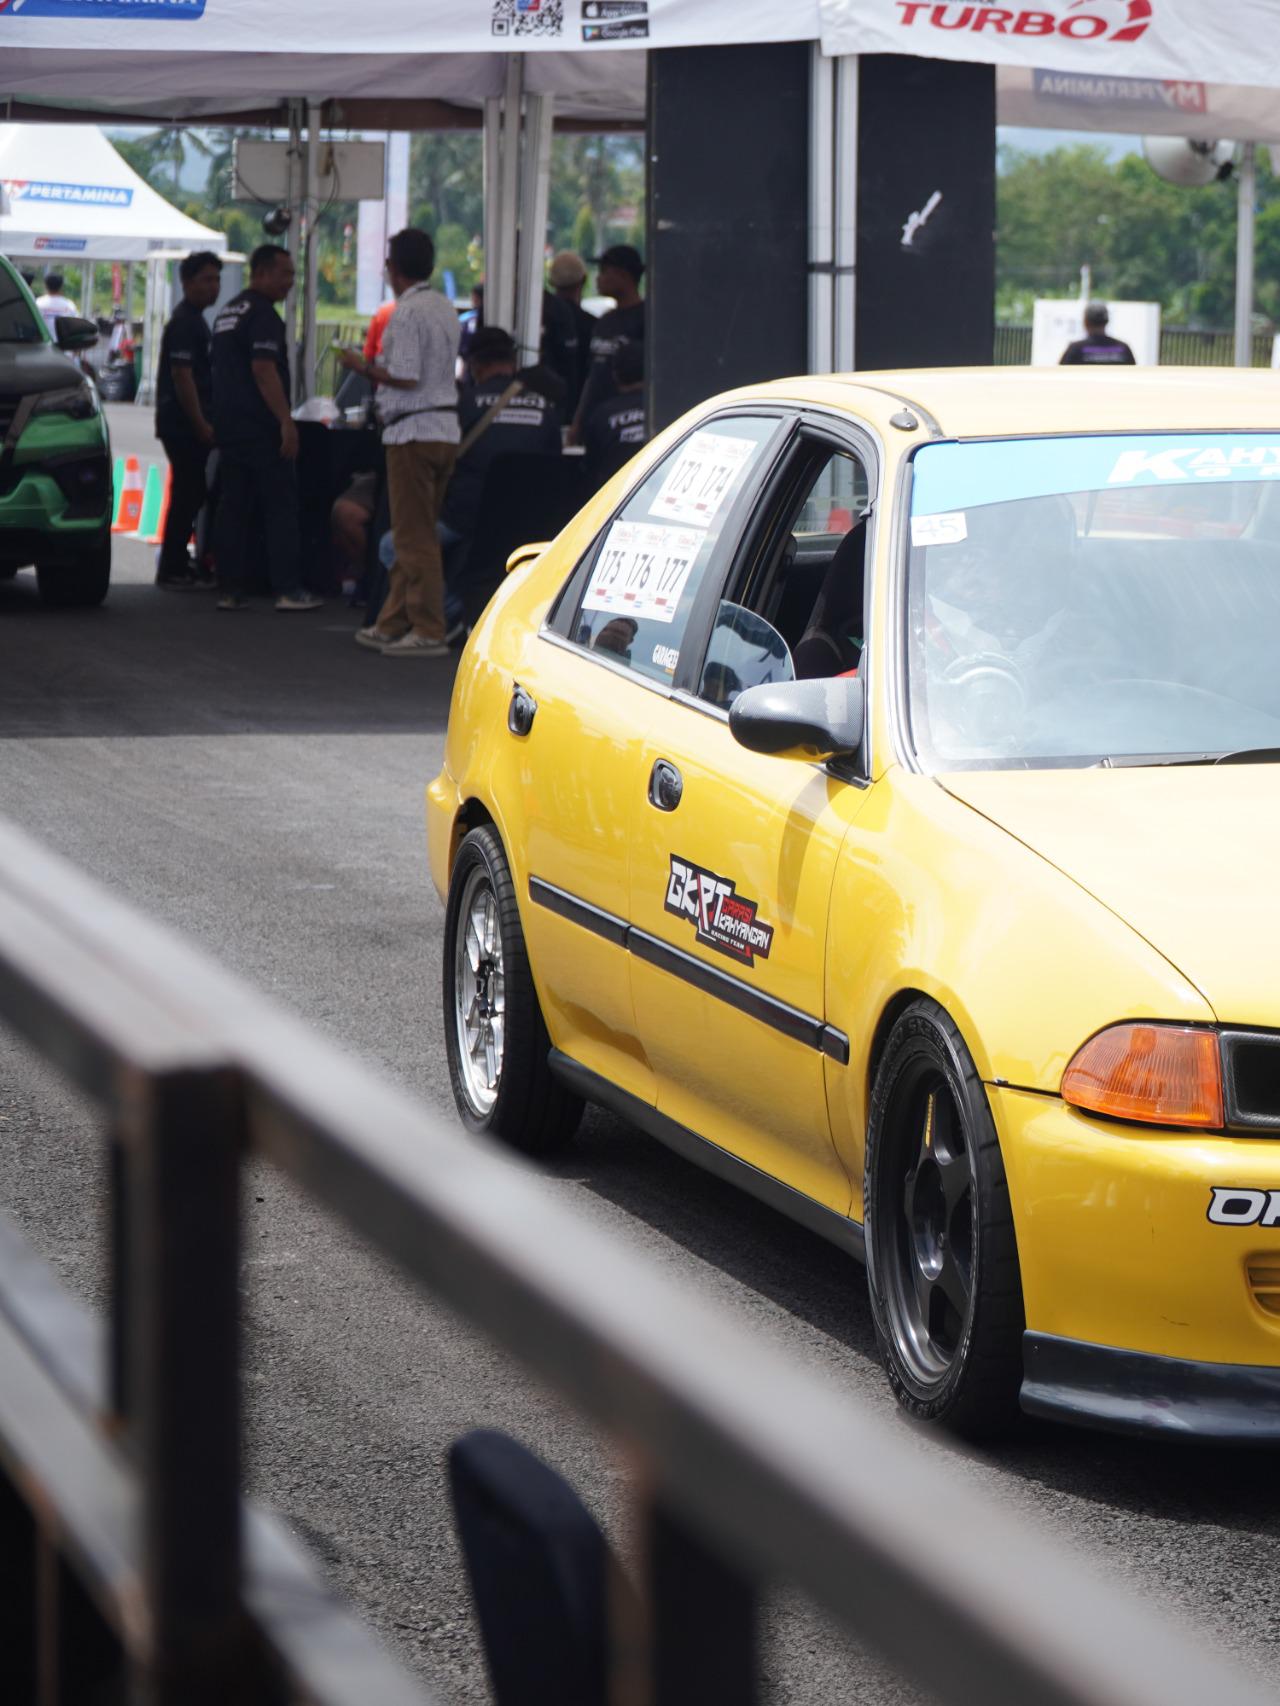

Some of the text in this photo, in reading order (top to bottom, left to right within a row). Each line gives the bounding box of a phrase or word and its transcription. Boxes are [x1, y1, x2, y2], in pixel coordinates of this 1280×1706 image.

[896, 2, 1108, 39] TURBO
[668, 459, 702, 494] 173
[597, 550, 689, 593] 175 176 177
[731, 938, 745, 950] TEAM
